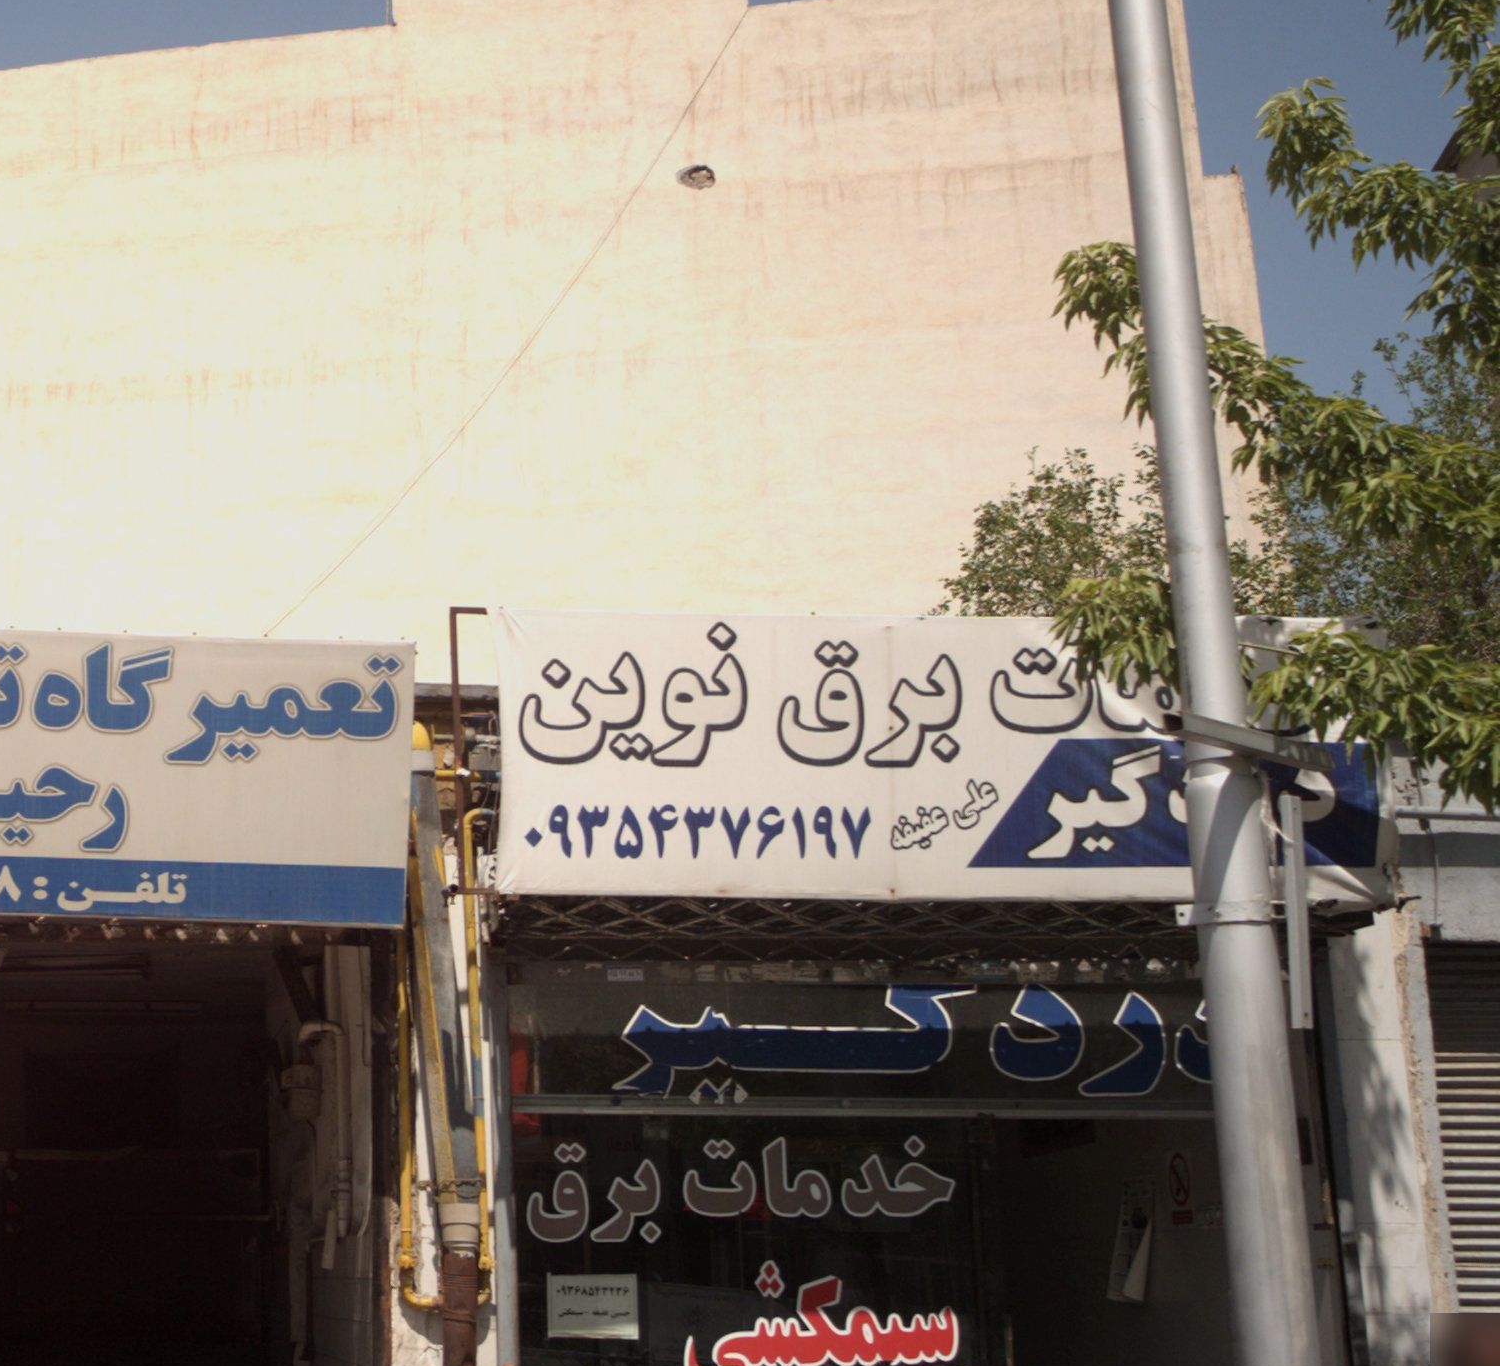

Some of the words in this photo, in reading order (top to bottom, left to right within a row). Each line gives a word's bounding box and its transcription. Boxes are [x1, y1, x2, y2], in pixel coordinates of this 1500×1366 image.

[517, 620, 750, 768] نوین
[776, 639, 964, 768] برق
[524, 803, 872, 860] ۰۹۳۵۴۳۷۶۱۹۷
[952, 778, 999, 830] علی
[526, 1142, 663, 1244] برق
[682, 1134, 957, 1218] خدمات
